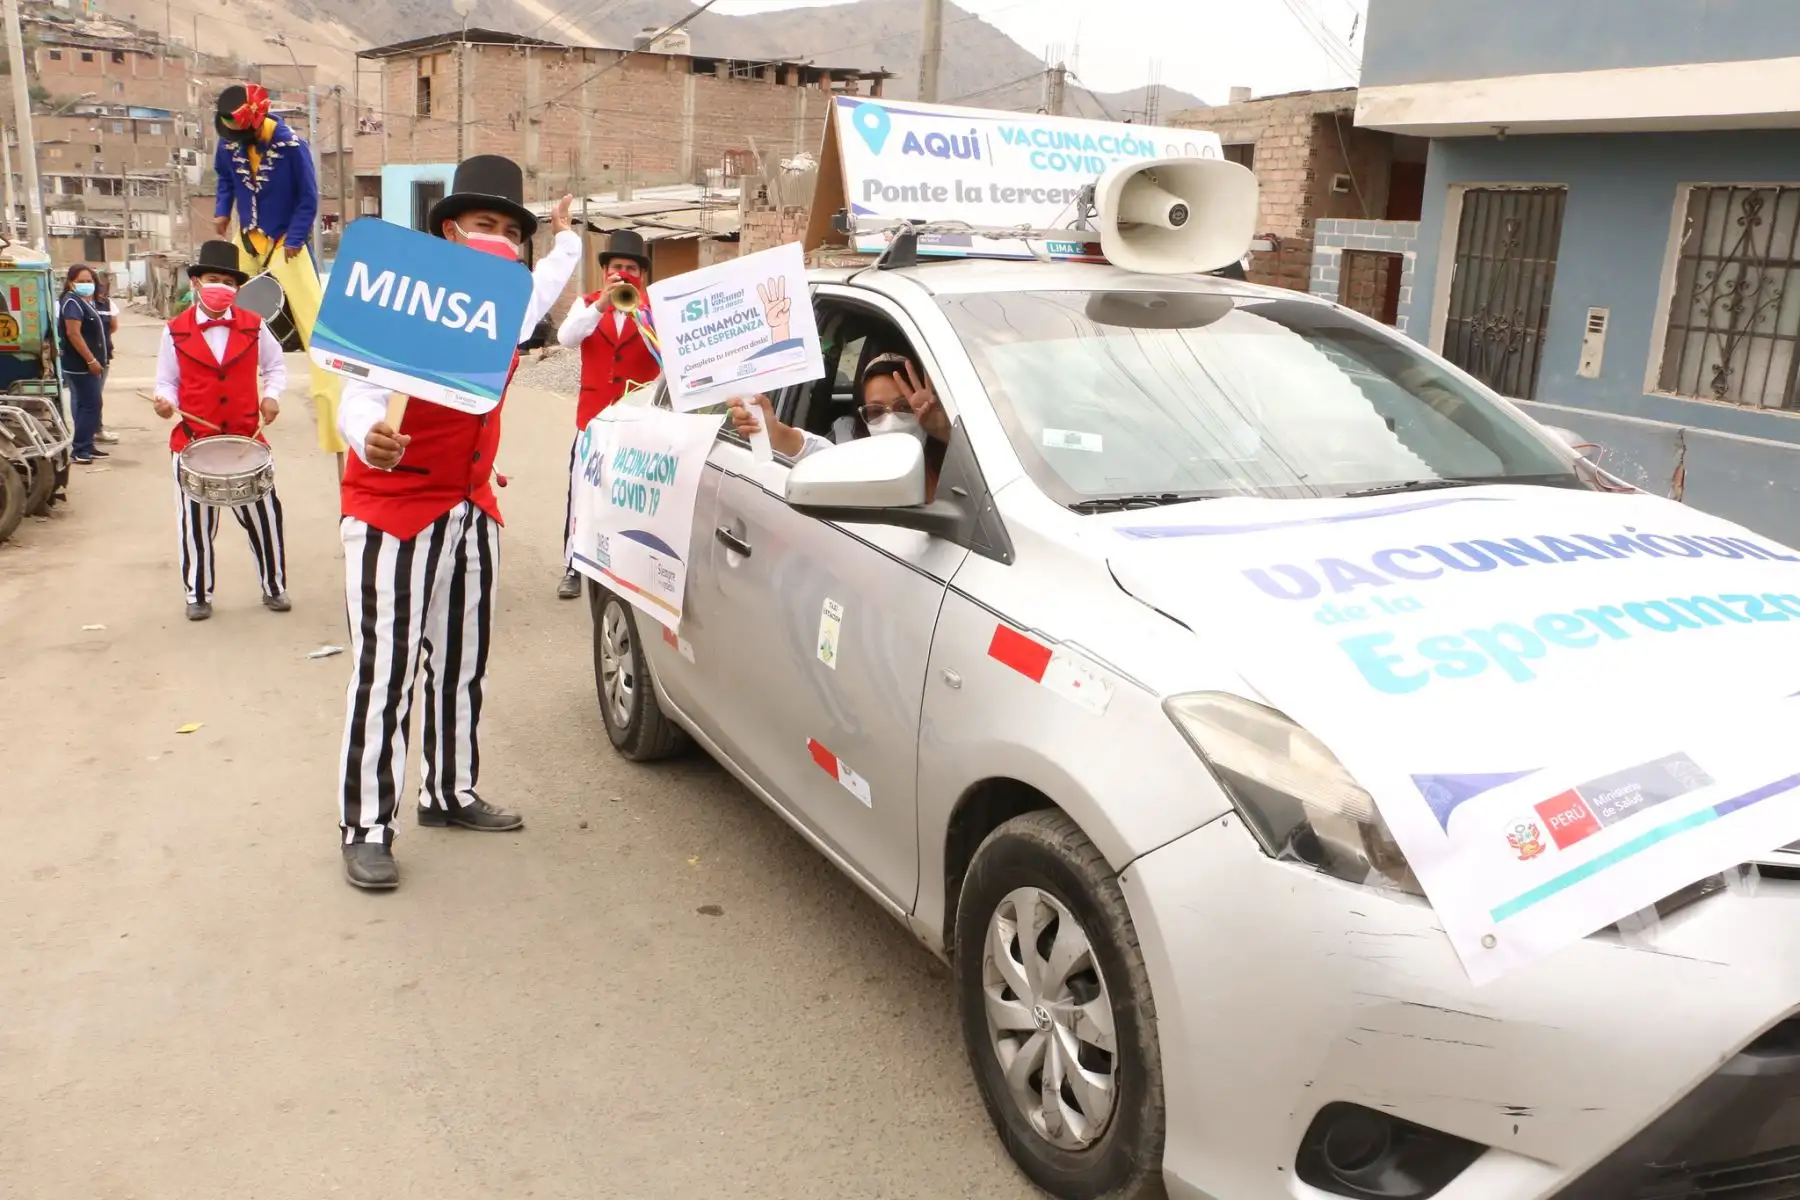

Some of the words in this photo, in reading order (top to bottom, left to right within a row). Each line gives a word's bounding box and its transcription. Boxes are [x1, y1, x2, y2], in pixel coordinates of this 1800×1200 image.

[902, 128, 980, 160] AQUÍ
[998, 126, 1157, 158] VACUNACIÓN
[1030, 150, 1106, 174] COVID
[862, 179, 948, 202] Ponte
[955, 179, 983, 203] la
[989, 183, 1081, 204] tercer
[345, 261, 497, 340] MINSA
[676, 307, 760, 345] VACUNAMÓVIL
[678, 346, 691, 356] DE
[692, 340, 706, 351] LA
[707, 319, 764, 346] ESPERANZA
[612, 445, 679, 487] VACUNACIÓN
[612, 477, 647, 513] COVID
[649, 488, 660, 517] 19
[1313, 601, 1367, 627] de
[1385, 595, 1425, 618] la
[1549, 804, 1586, 830] PERÚ
[1602, 807, 1616, 817] de
[1615, 793, 1644, 811] Salud
